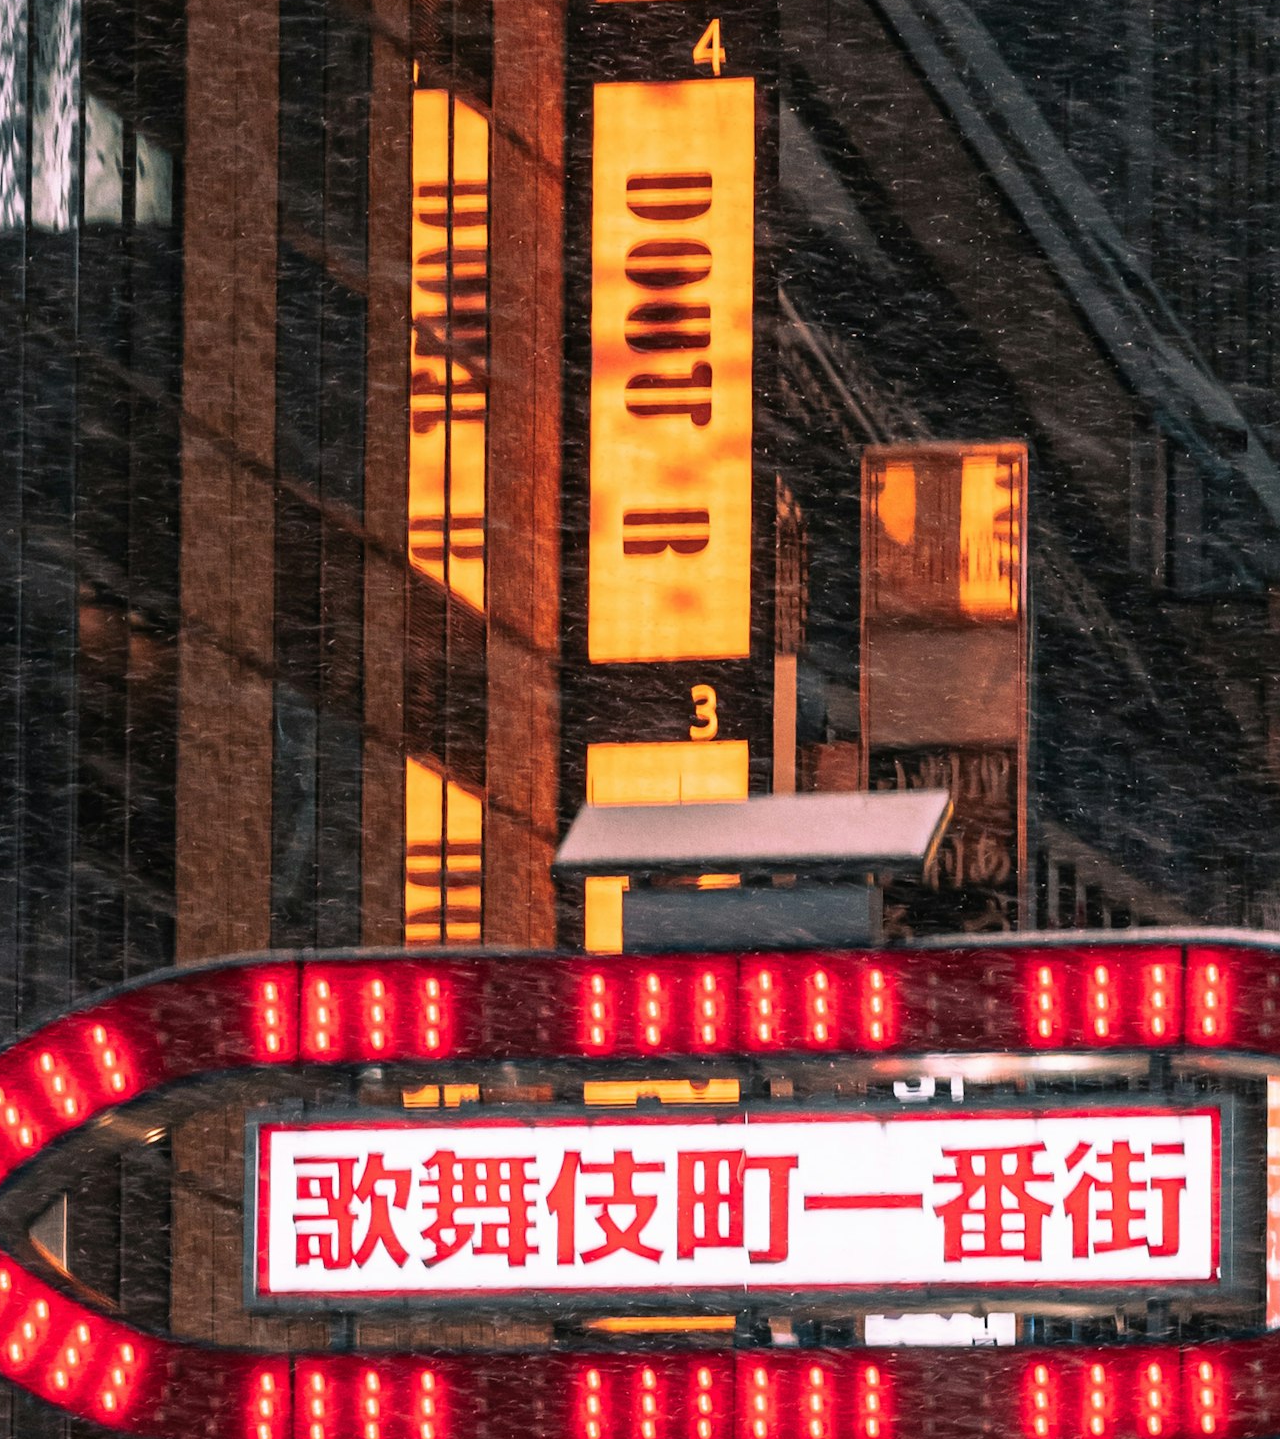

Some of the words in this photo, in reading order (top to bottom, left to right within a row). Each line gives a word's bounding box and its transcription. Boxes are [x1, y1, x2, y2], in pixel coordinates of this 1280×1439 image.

[692, 18, 726, 77] 4
[623, 172, 713, 557] DOUTR
[689, 684, 718, 741] 3
[293, 1139, 1187, 1269] 歌舞伎町一番街
